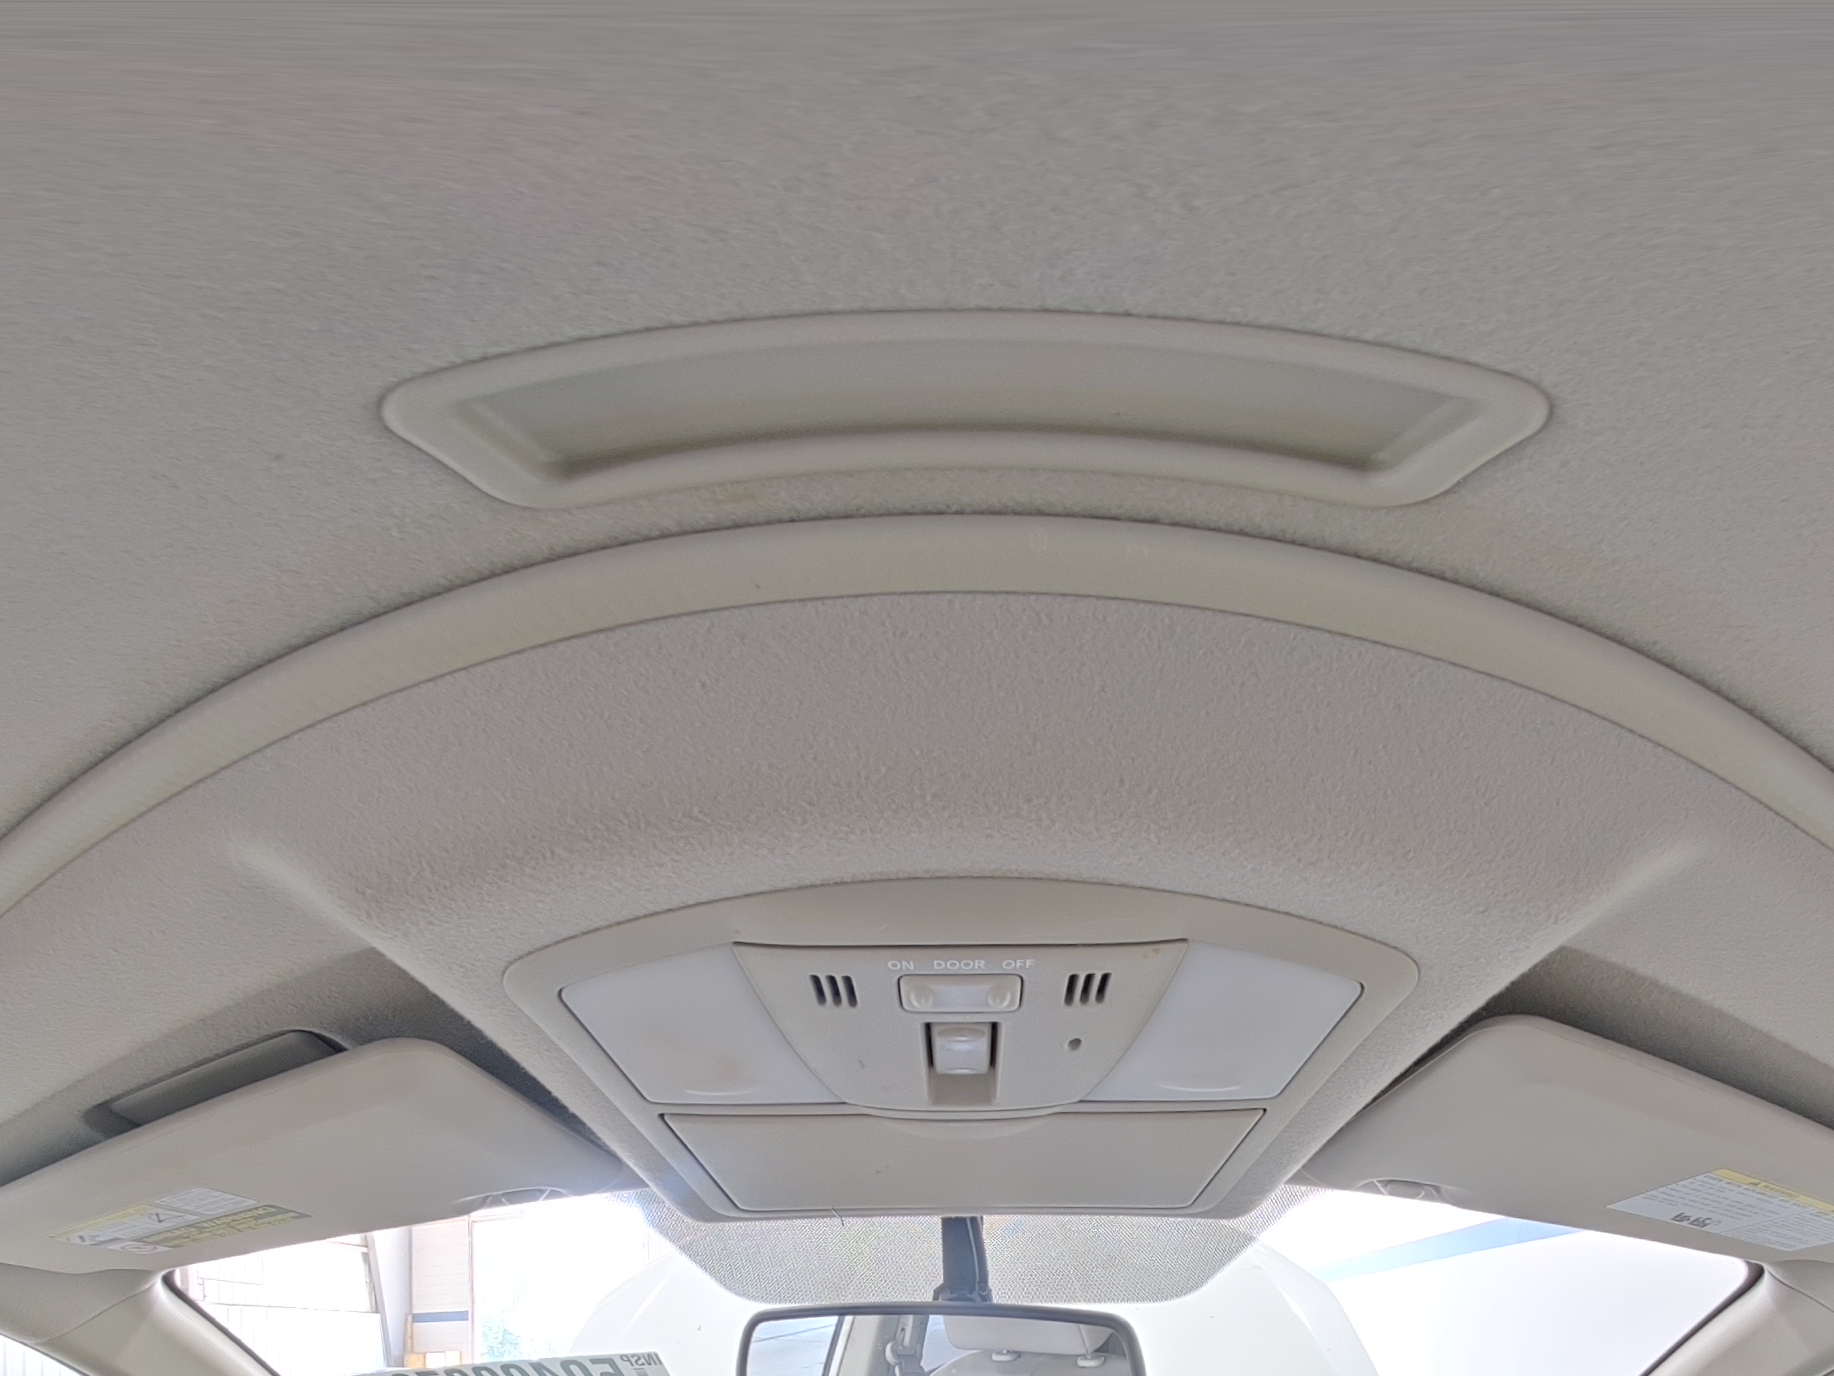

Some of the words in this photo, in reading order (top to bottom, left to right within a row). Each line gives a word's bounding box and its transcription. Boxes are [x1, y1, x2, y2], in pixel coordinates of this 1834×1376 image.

[887, 960, 914, 971] ON
[933, 959, 986, 970] DOOR
[1002, 959, 1035, 970] OFF
